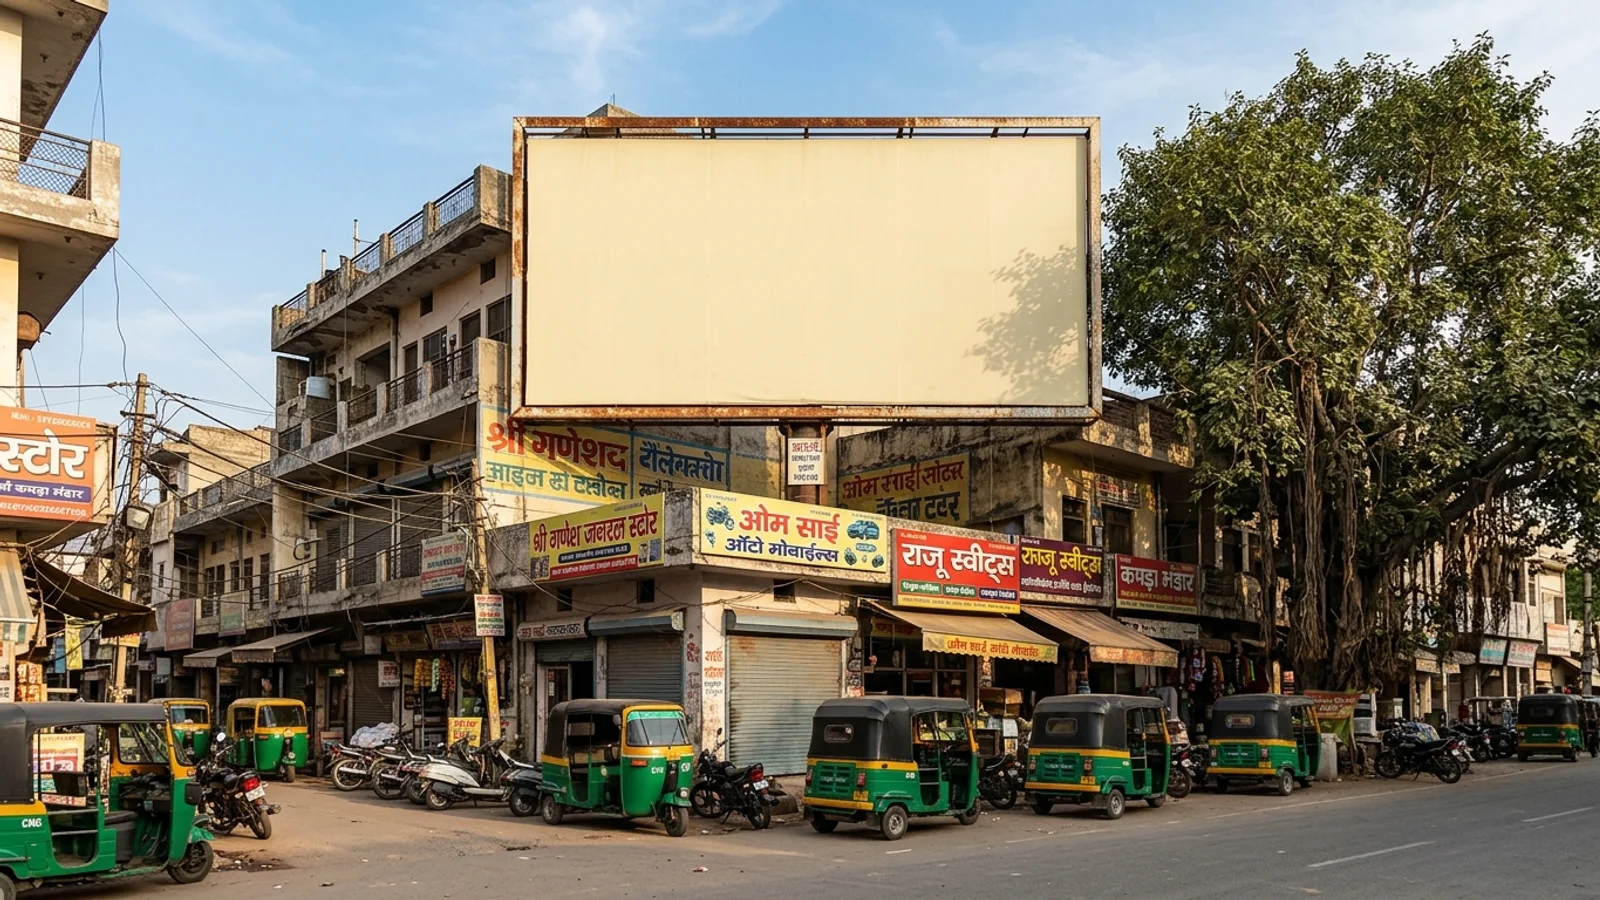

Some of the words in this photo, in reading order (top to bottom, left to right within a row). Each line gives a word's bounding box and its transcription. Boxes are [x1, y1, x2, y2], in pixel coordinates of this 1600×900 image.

[0, 427, 89, 479] स्टोर
[486, 417, 526, 456] श्री
[549, 519, 582, 550] गणेश
[628, 504, 659, 538] स्टोर
[738, 503, 790, 535] ओम
[795, 513, 841, 545] साई
[900, 542, 951, 580] राजू
[949, 542, 1016, 585] स्वीट्स
